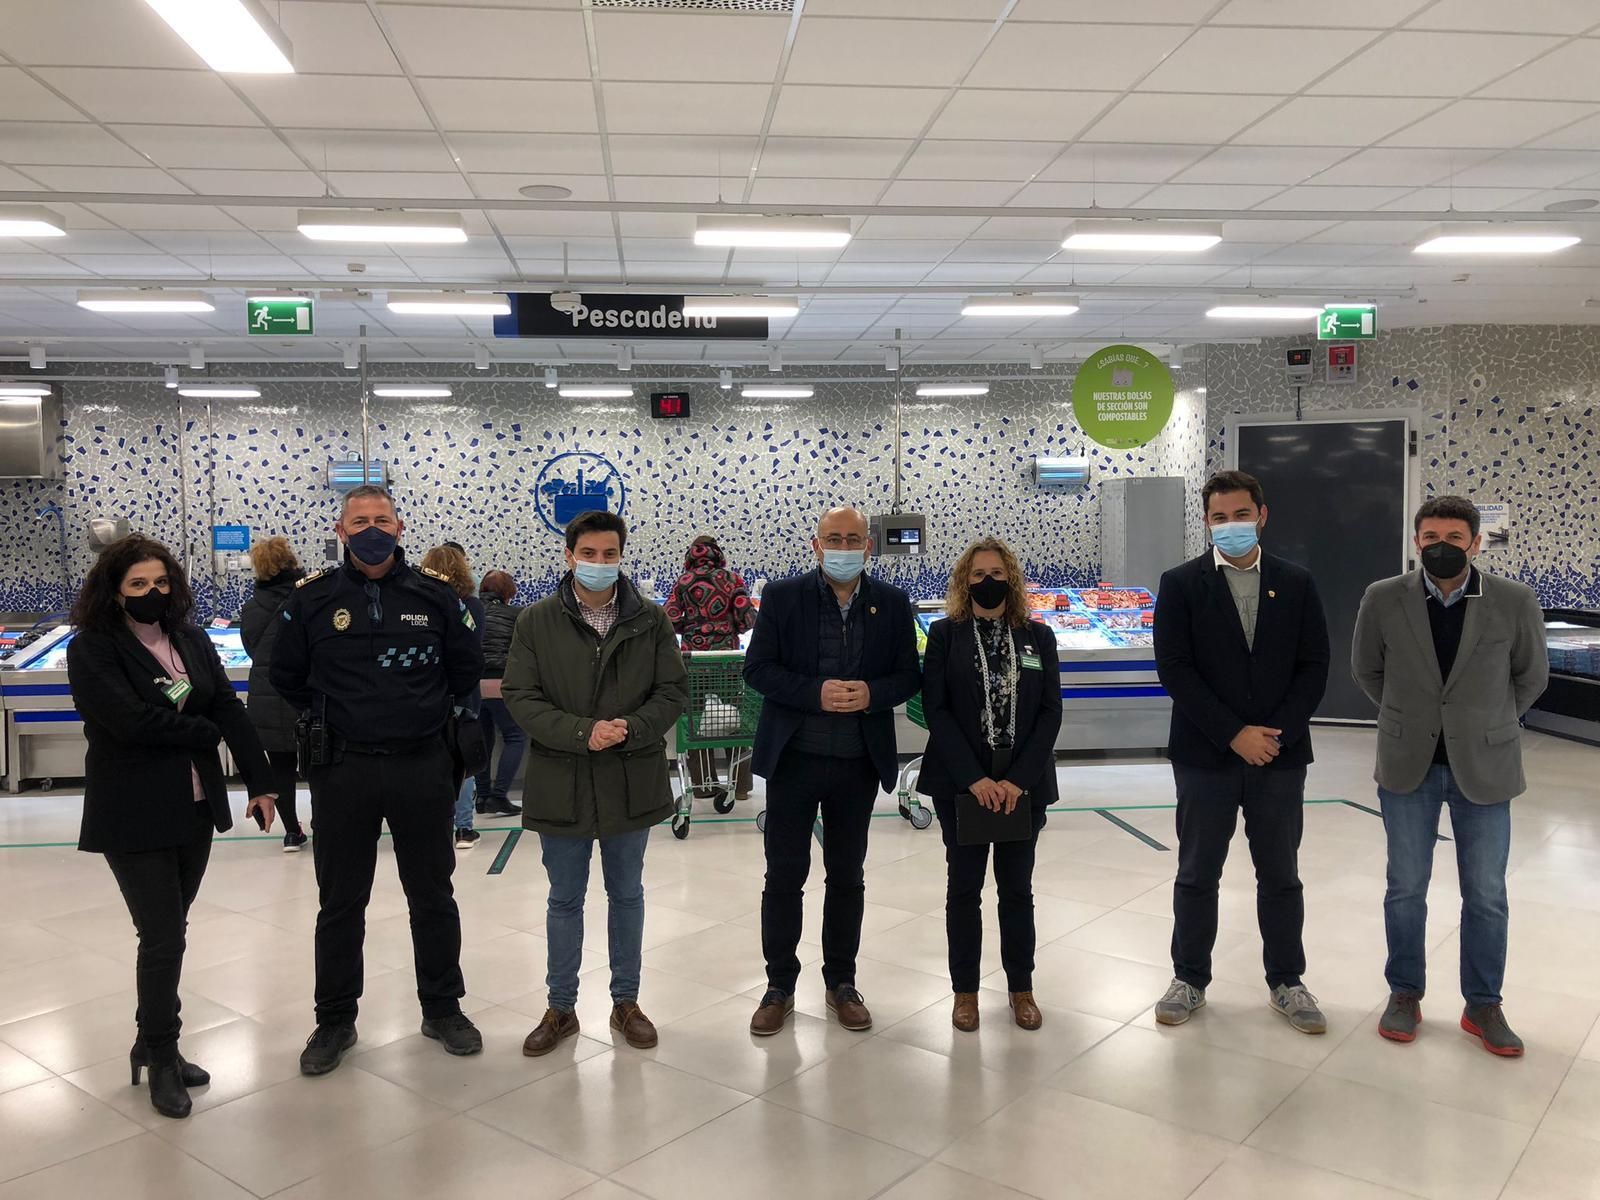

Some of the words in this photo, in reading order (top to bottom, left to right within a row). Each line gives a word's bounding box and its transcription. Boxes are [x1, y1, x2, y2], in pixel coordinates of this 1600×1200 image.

[1093, 391, 1126, 401] NUESTRAS
[1126, 391, 1152, 401] BOLSAS
[1097, 402, 1106, 411] DE
[1106, 400, 1134, 411] SECCIÓN
[1134, 402, 1148, 411] SON
[1097, 412, 1148, 421] COMPOSTABLES
